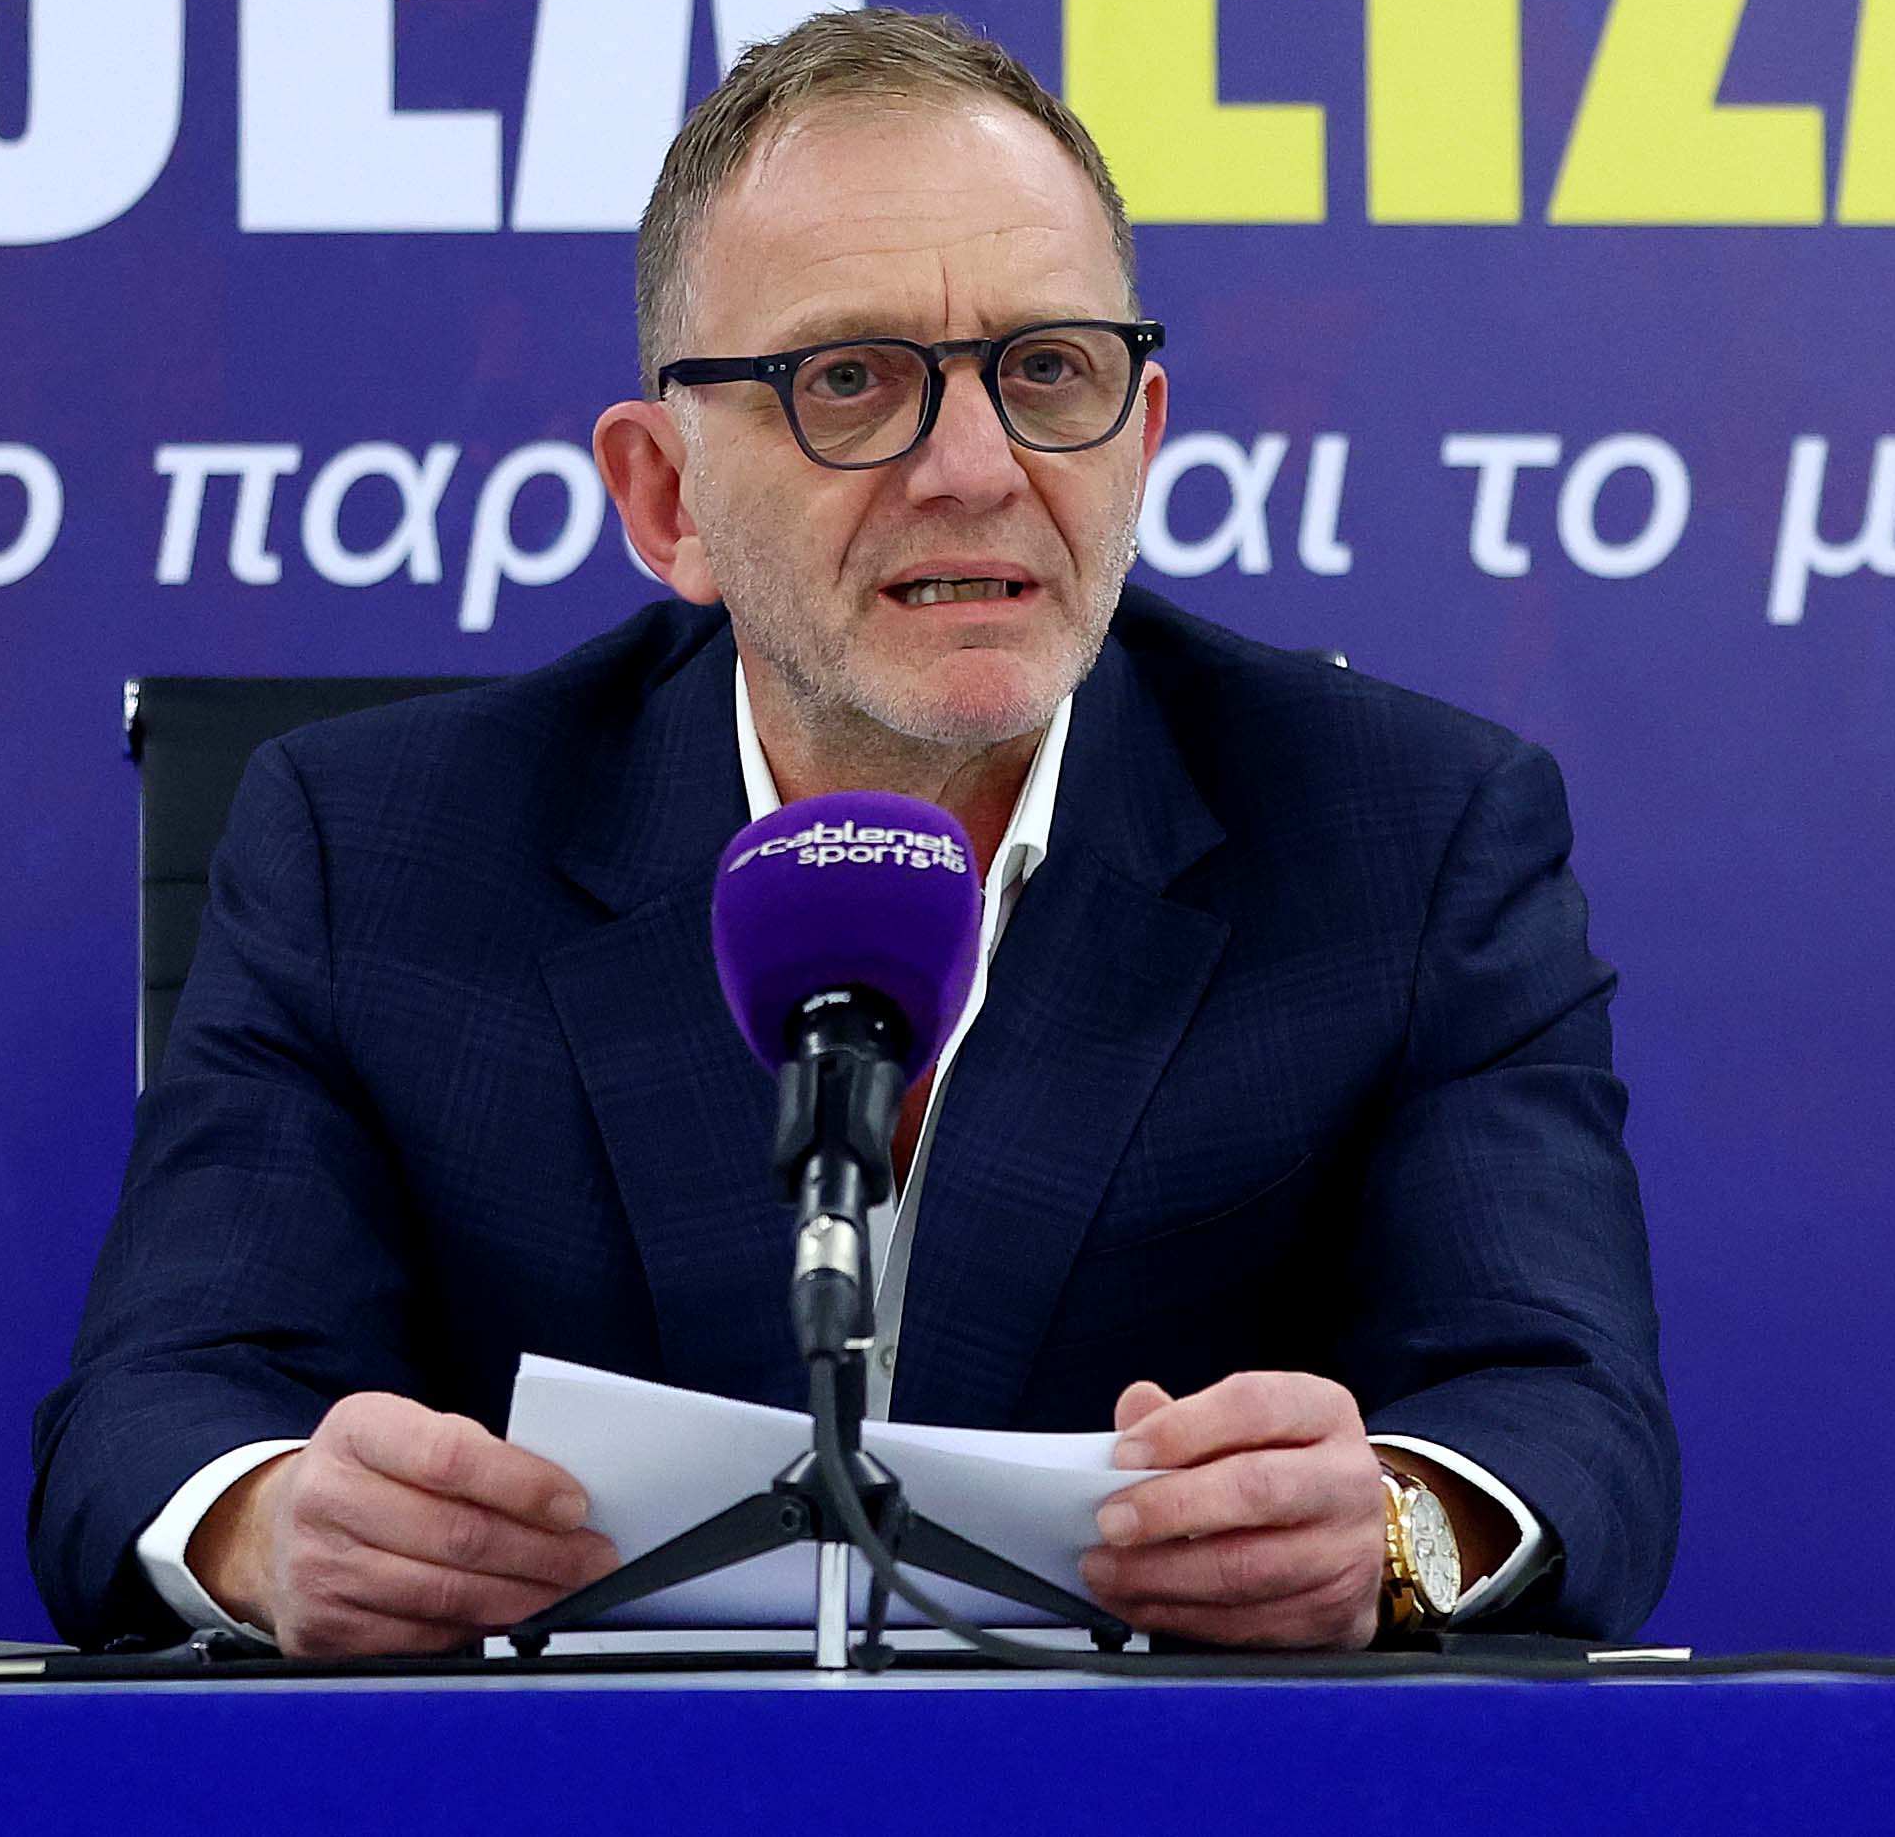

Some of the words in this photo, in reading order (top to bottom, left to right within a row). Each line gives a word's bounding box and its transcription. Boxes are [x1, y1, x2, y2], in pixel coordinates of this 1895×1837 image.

[155, 440, 671, 634] παρ
[1134, 431, 1354, 579] αι
[1440, 434, 1691, 579] το
[758, 819, 966, 859] cablenet
